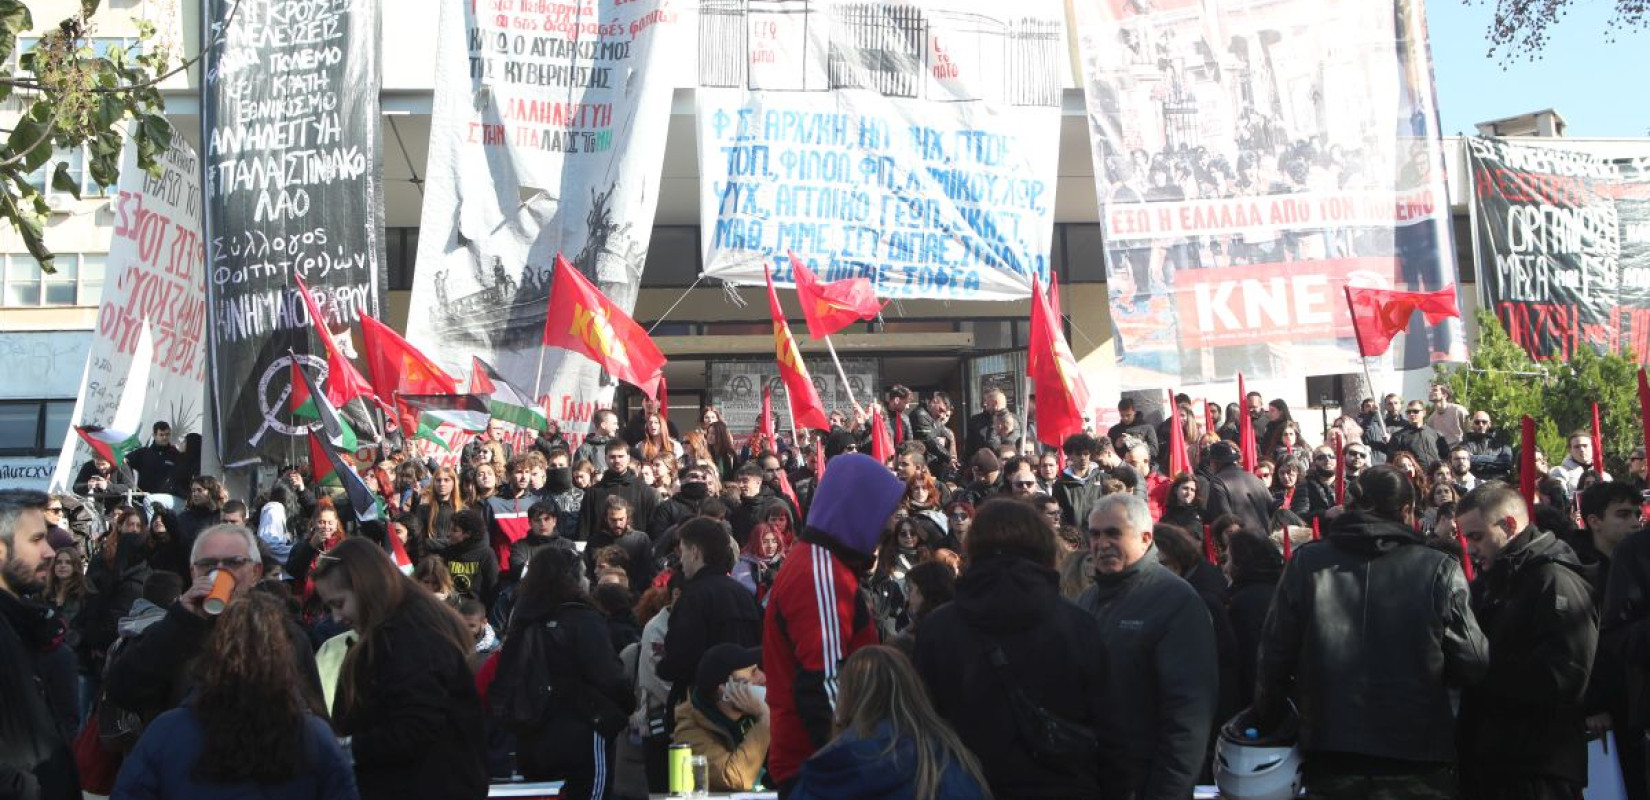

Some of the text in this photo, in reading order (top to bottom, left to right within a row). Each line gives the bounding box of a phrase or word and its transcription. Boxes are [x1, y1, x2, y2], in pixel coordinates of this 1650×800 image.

[270, 47, 342, 74] ΠΟΛΕΜΟ
[504, 61, 613, 89] ΚΥΒΕΡΝΗΣΗΣ
[254, 188, 310, 222] ΛΑΟ
[1111, 210, 1151, 234] ΕΞΩ
[1159, 209, 1173, 232] Η
[1180, 202, 1263, 229] ΕΛΛΑΔΑ
[1270, 198, 1310, 225] ΑΠΟ
[213, 228, 327, 261] Σύλλογος
[1193, 273, 1333, 332] ΚΝΕ
